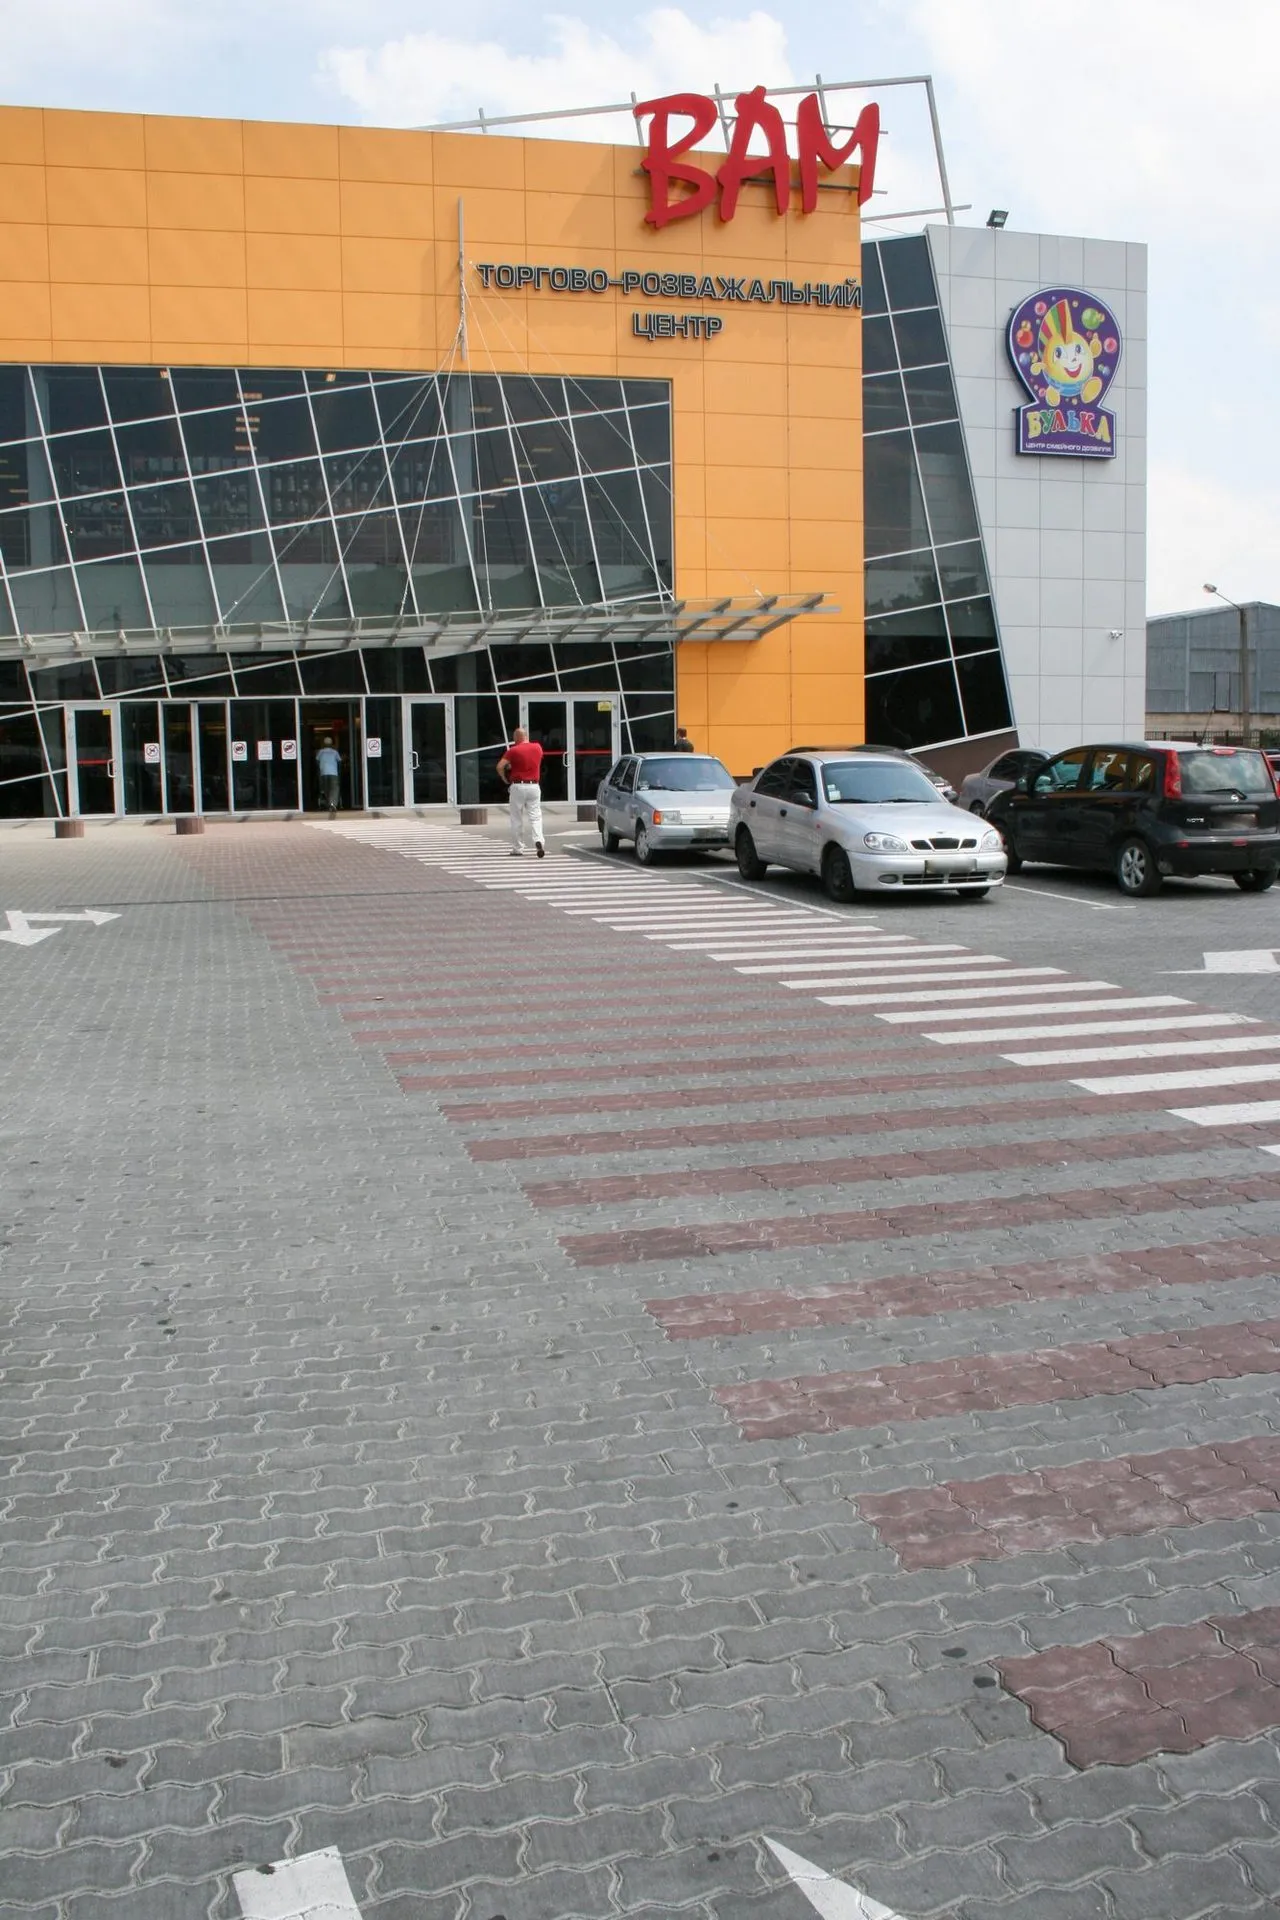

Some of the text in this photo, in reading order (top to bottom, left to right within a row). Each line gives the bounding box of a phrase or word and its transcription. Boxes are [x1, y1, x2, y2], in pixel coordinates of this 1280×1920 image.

[477, 264, 862, 308] ТОРГОВО-РОЗВАЖАЛЬНИЙ
[633, 312, 723, 341] ЦЕНТР
[1026, 409, 1111, 443] БУЛЬКА
